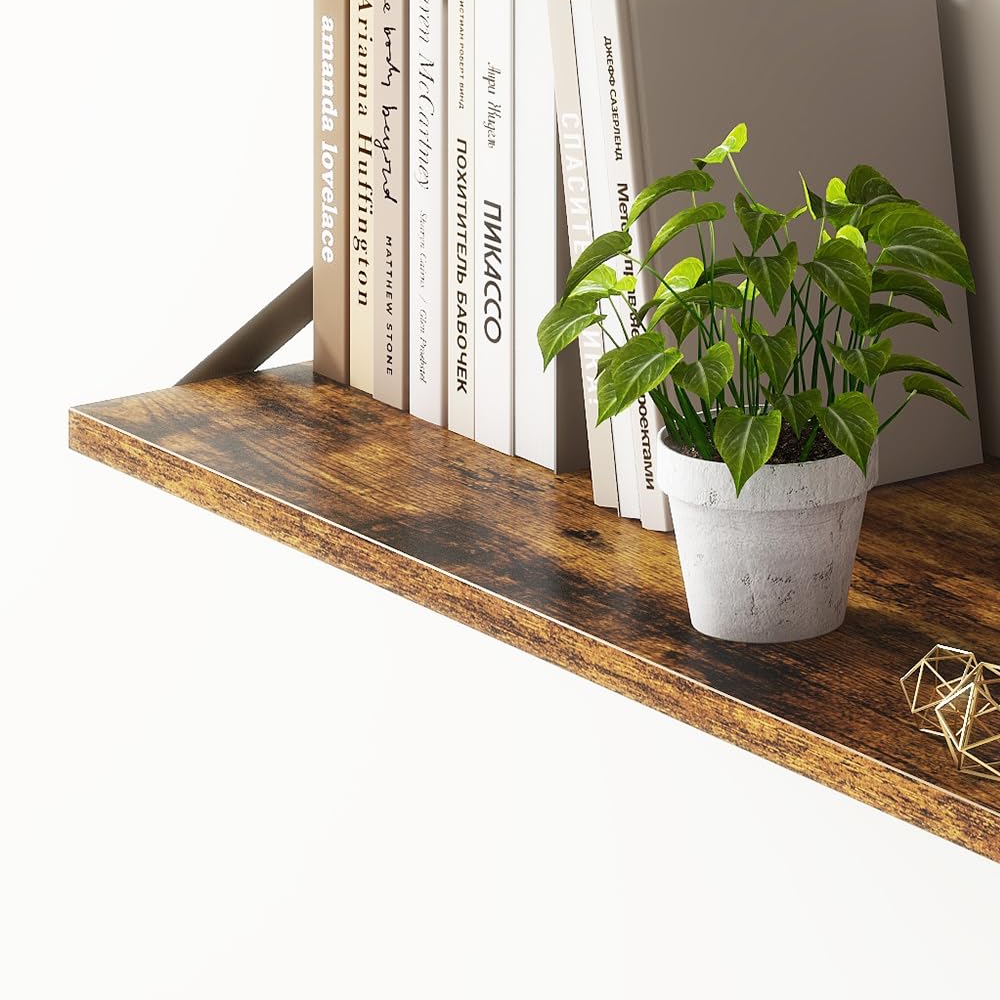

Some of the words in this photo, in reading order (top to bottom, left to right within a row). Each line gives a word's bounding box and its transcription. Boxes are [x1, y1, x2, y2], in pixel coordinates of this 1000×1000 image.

[321, 15, 338, 132] amanda
[381, 26, 400, 87] body
[603, 35, 616, 87] ДЖЕФФ
[374, 105, 398, 204] beyond
[417, 53, 435, 190] McCartney
[609, 88, 623, 161] САЗЕРЛЕНД
[321, 140, 338, 264] lovelace
[353, 132, 373, 307] Huffington
[457, 138, 467, 284] ПОХИТИТЕЛЬ
[385, 235, 393, 316] MATTHEW
[483, 199, 502, 344] ПИКАССО
[457, 290, 467, 394] БАБОЧЕК
[617, 183, 630, 233] Мето
[637, 393, 656, 491] роектами
